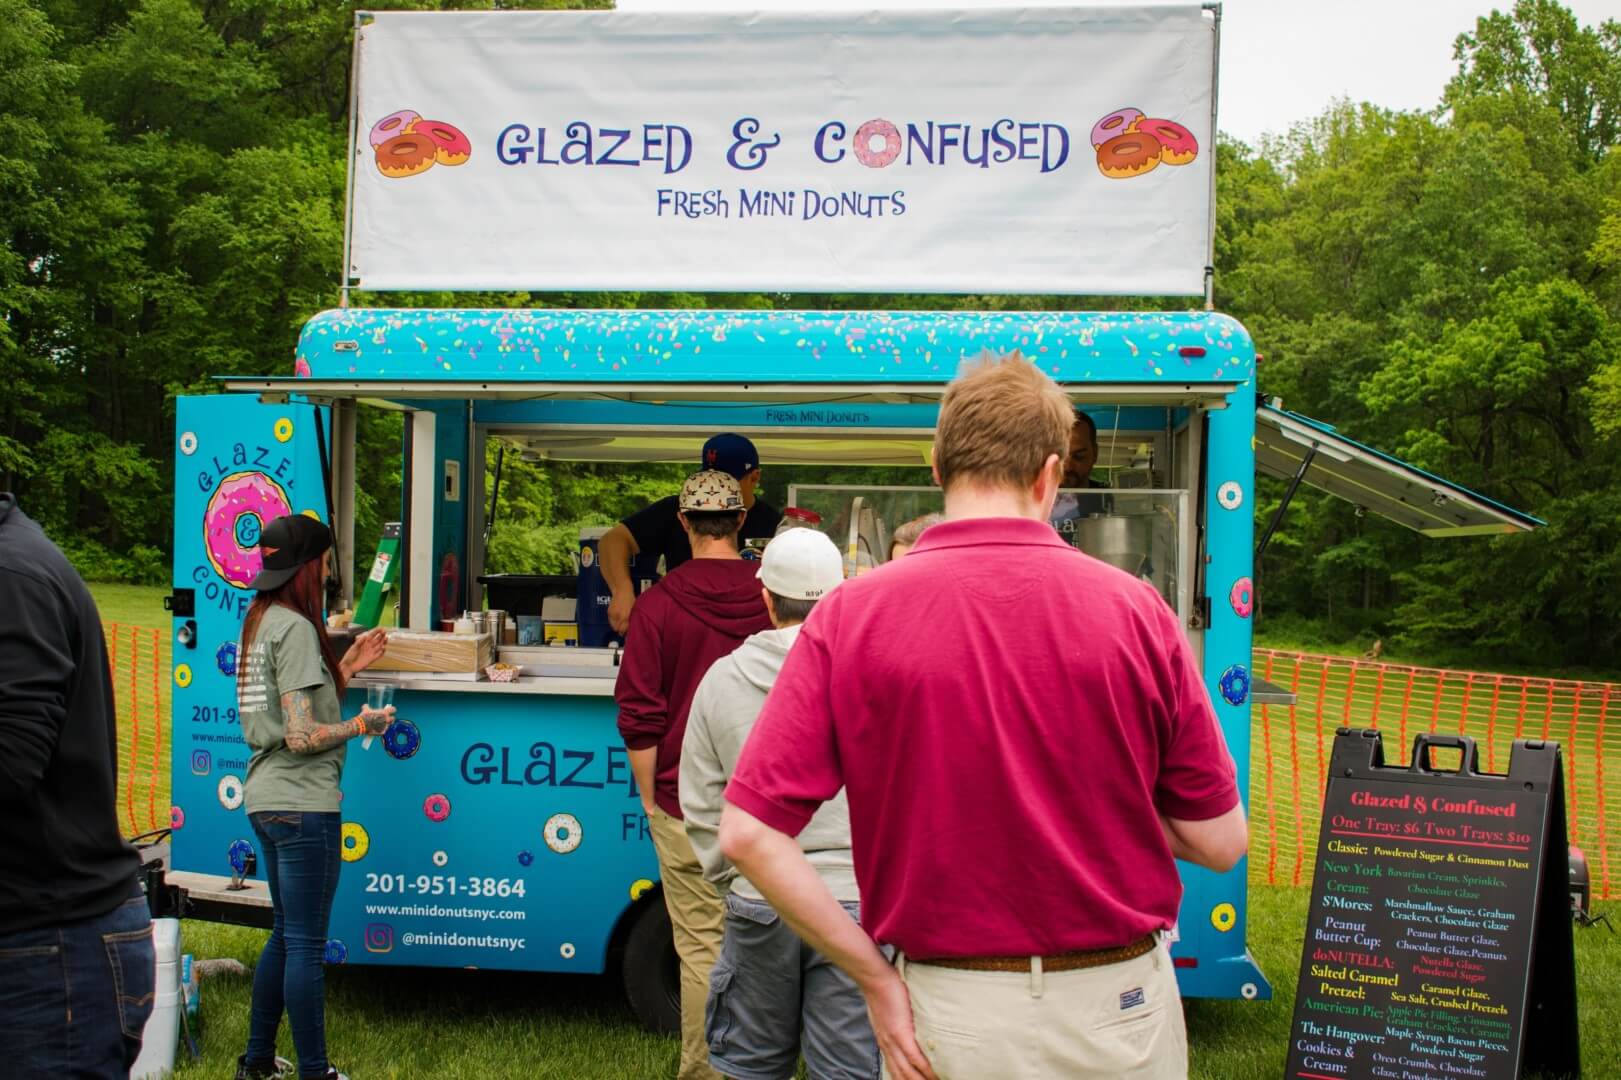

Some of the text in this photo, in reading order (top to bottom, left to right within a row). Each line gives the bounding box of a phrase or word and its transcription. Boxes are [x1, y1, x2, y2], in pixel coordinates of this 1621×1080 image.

[726, 117, 781, 171] &
[240, 518, 259, 541] &
[193, 566, 254, 620] CONF
[192, 705, 241, 724] 201-9
[1350, 791, 1517, 817] Glazed & Confused
[1331, 815, 1360, 829] One
[1366, 816, 1400, 835] Tray:
[1404, 821, 1420, 834] $6
[1424, 821, 1456, 837] Two
[1460, 824, 1503, 843] Trays:
[1327, 840, 1529, 869] Classic: Powdered Sugar & Cinnamon Dust
[1323, 860, 1383, 877] New York
[1387, 867, 1425, 879] Bavarian
[365, 872, 526, 898] 201-951-3864
[1327, 880, 1369, 894] Cream:
[1407, 883, 1480, 899] Chocolate Glaze
[365, 903, 526, 921] www.minidonutsnyc.com
[1322, 895, 1373, 911] S'Mores:
[1384, 898, 1516, 920] Marshmallow Sauce, Graham
[1325, 916, 1367, 932] Peanut
[1435, 914, 1481, 928] Chocolate
[1483, 920, 1510, 931] Glaze
[402, 932, 526, 949] @minidonutsnyc
[1315, 929, 1382, 950] Butter Cup:
[1406, 927, 1438, 940] Peanut
[1440, 931, 1470, 943] Butter
[1395, 940, 1442, 953] Chocolate
[1312, 948, 1395, 969] doNUTELLA:
[1421, 954, 1454, 967] Nutella
[1311, 964, 1399, 987] Salted Caramel
[1412, 965, 1487, 983] Powdered Sugar
[1320, 982, 1366, 999] Pretzel:
[1421, 983, 1460, 996] Caramel
[1303, 998, 1384, 1018] American Pie:
[1387, 1005, 1413, 1018] Apple
[1415, 1008, 1427, 1018] Pie
[1391, 992, 1407, 1002] Sea
[1431, 997, 1470, 1011] Crushed
[1471, 1001, 1508, 1015] Pretzels
[1301, 1020, 1385, 1044] The Hangover:
[1385, 1026, 1414, 1039] Maple
[1448, 1035, 1476, 1047] Bacon
[1387, 1016, 1423, 1029] Graham
[1471, 1026, 1511, 1039] Caramel
[1297, 1039, 1355, 1058] Cookies &
[1410, 1042, 1486, 1063] Powdered Sugar
[1303, 1056, 1348, 1073] Cream:
[1372, 1051, 1396, 1064] Oreo
[1439, 1061, 1487, 1077] Chocolate
